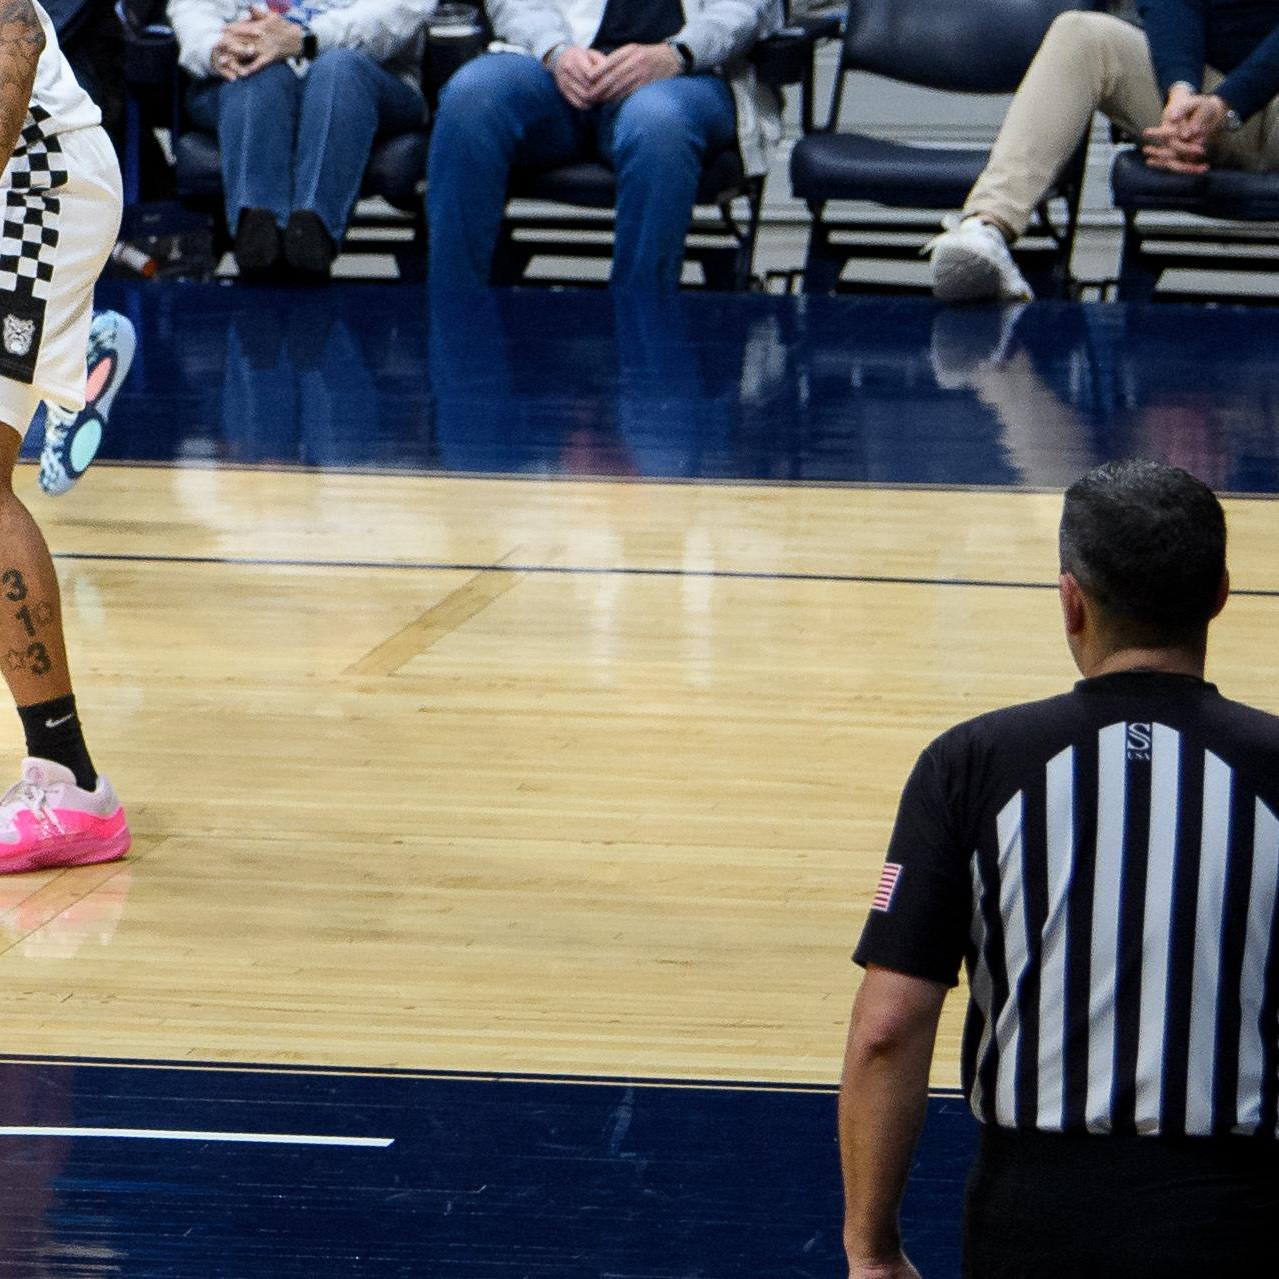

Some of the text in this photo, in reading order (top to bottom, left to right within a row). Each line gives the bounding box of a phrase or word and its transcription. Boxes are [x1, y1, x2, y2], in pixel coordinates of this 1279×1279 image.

[2, 568, 28, 602] 3
[15, 605, 36, 637] 1
[27, 642, 52, 675] 3
